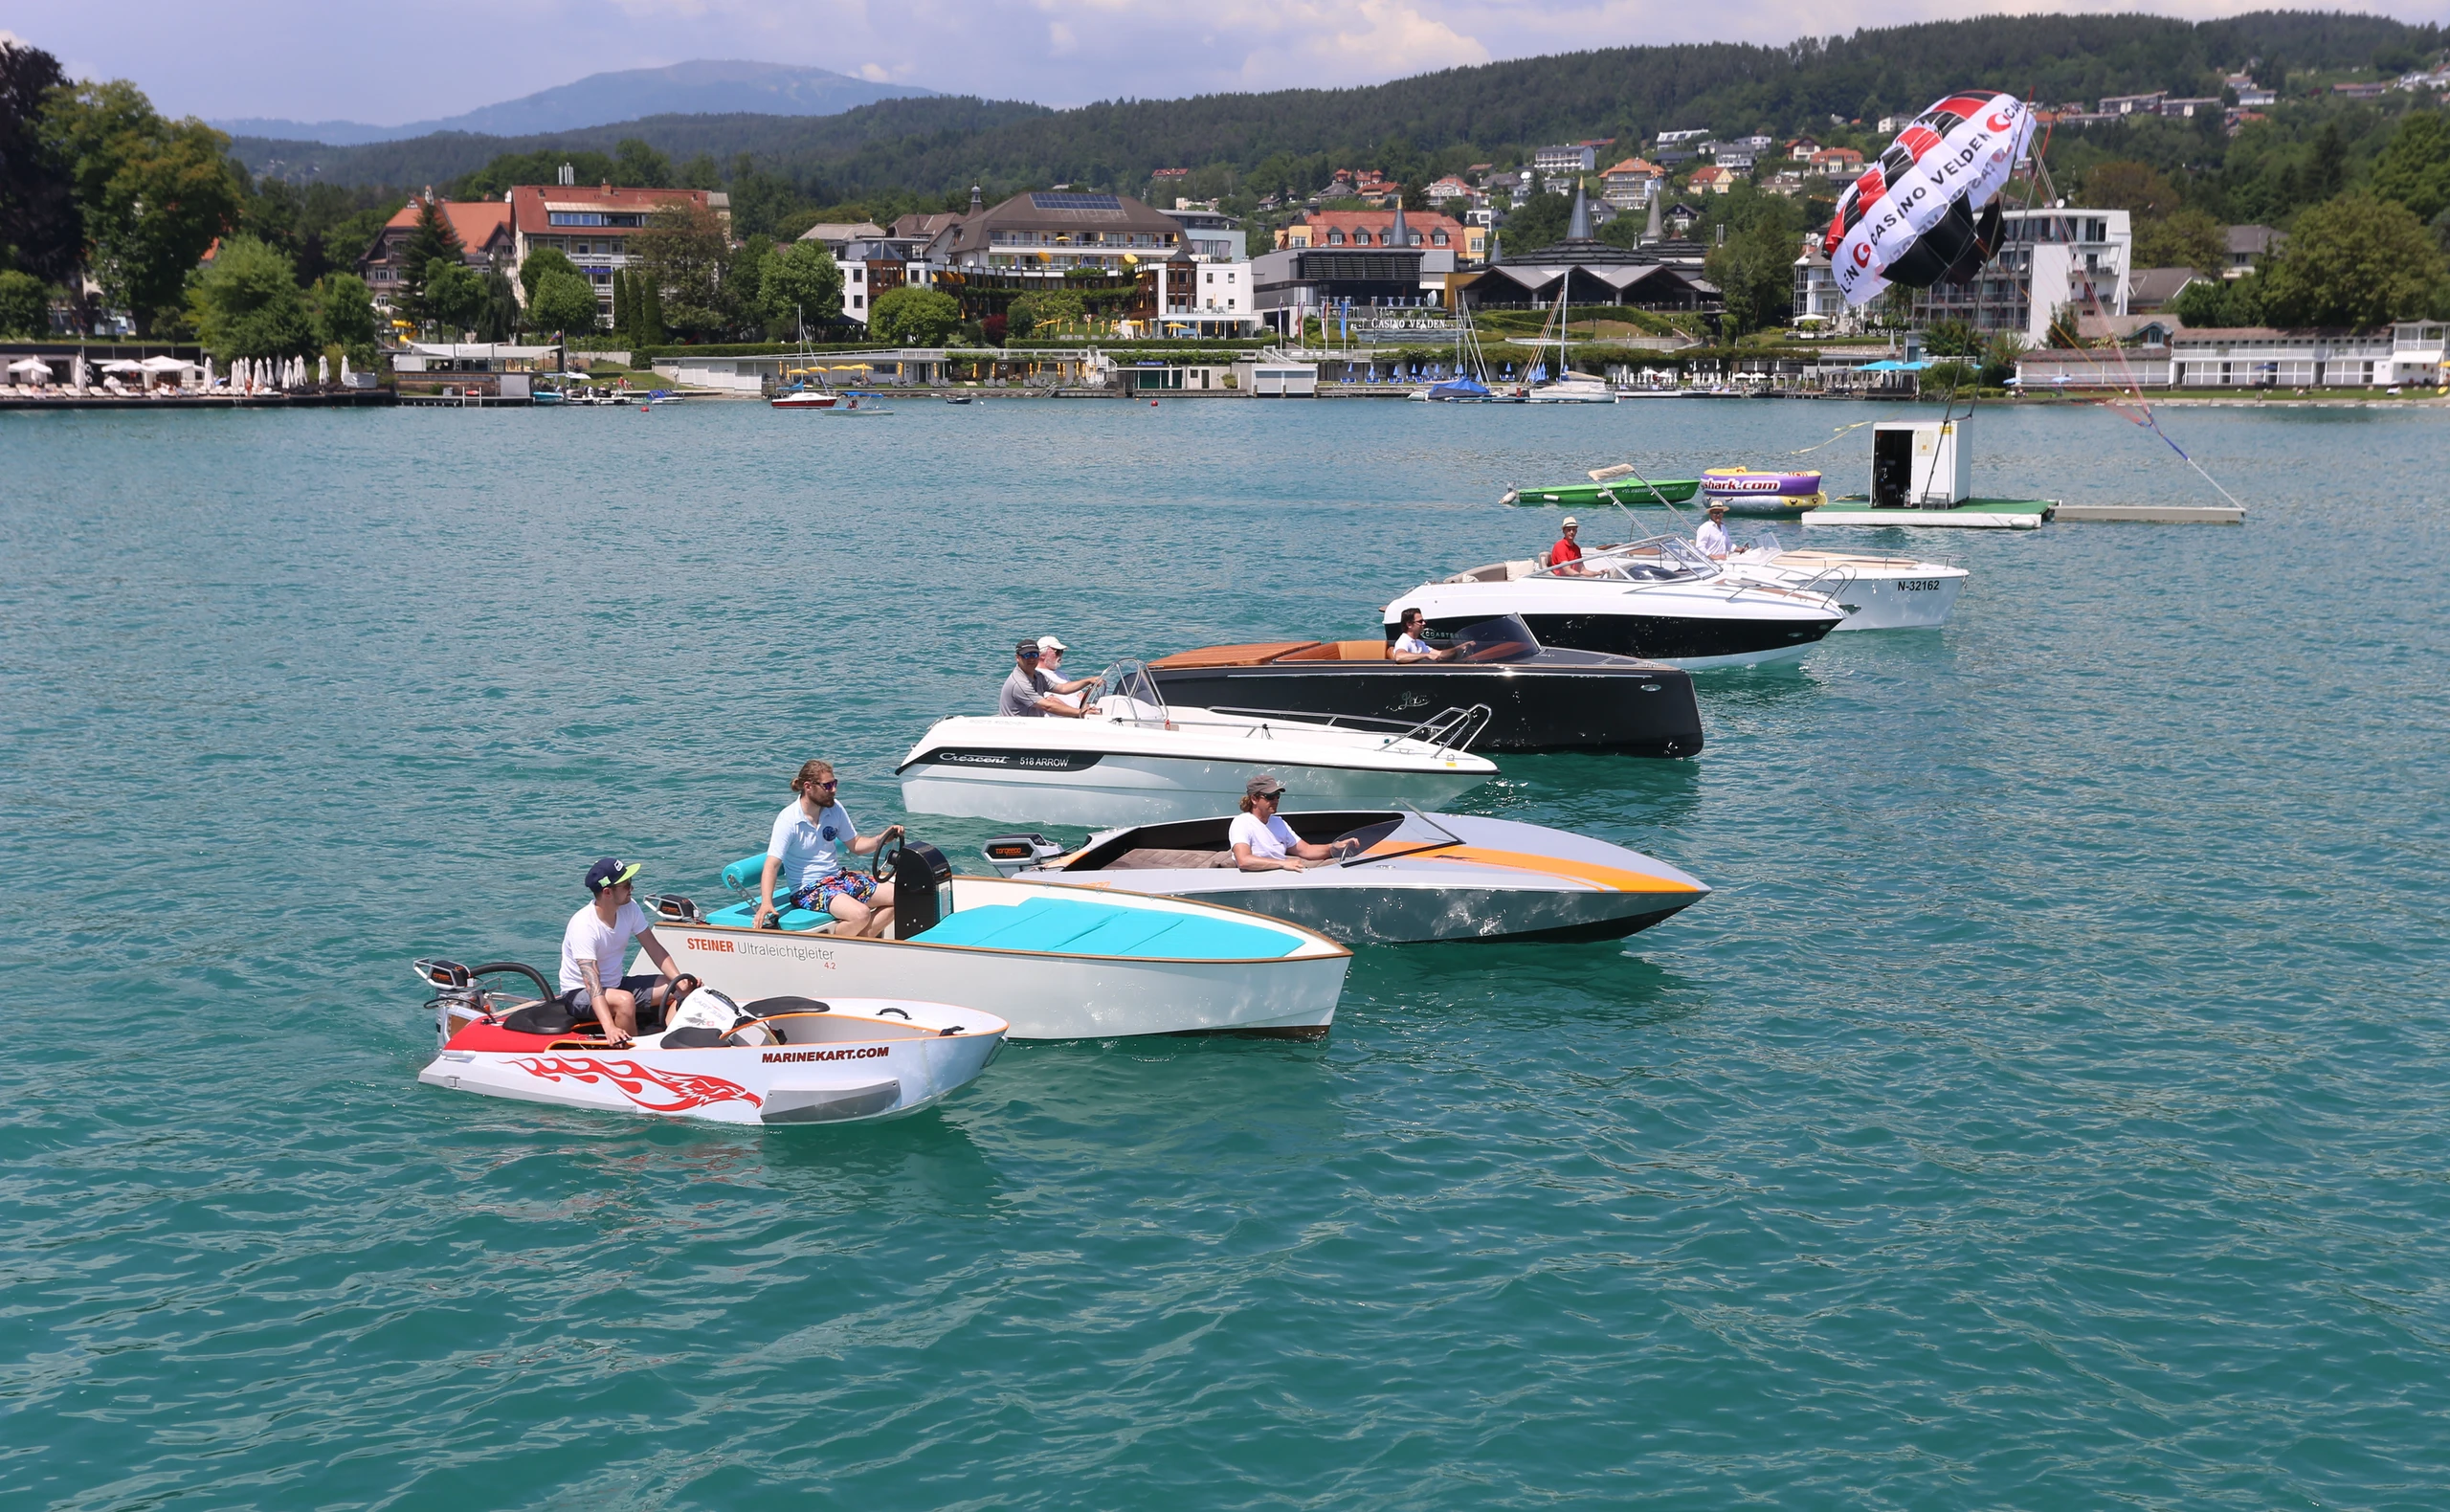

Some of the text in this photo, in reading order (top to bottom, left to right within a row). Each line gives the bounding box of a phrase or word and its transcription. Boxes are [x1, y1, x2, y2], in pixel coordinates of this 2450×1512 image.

[1870, 132, 1993, 246] CASINO VELDEN
[1371, 318, 1405, 329] CASINO
[1898, 580, 1940, 591] N-32162
[939, 752, 1069, 767] Crescent 518 ARROW
[687, 937, 835, 961] STEINER Ultraleichtgleiter
[824, 962, 836, 970] 4.2
[762, 1047, 889, 1063] MARINEKART.COM
